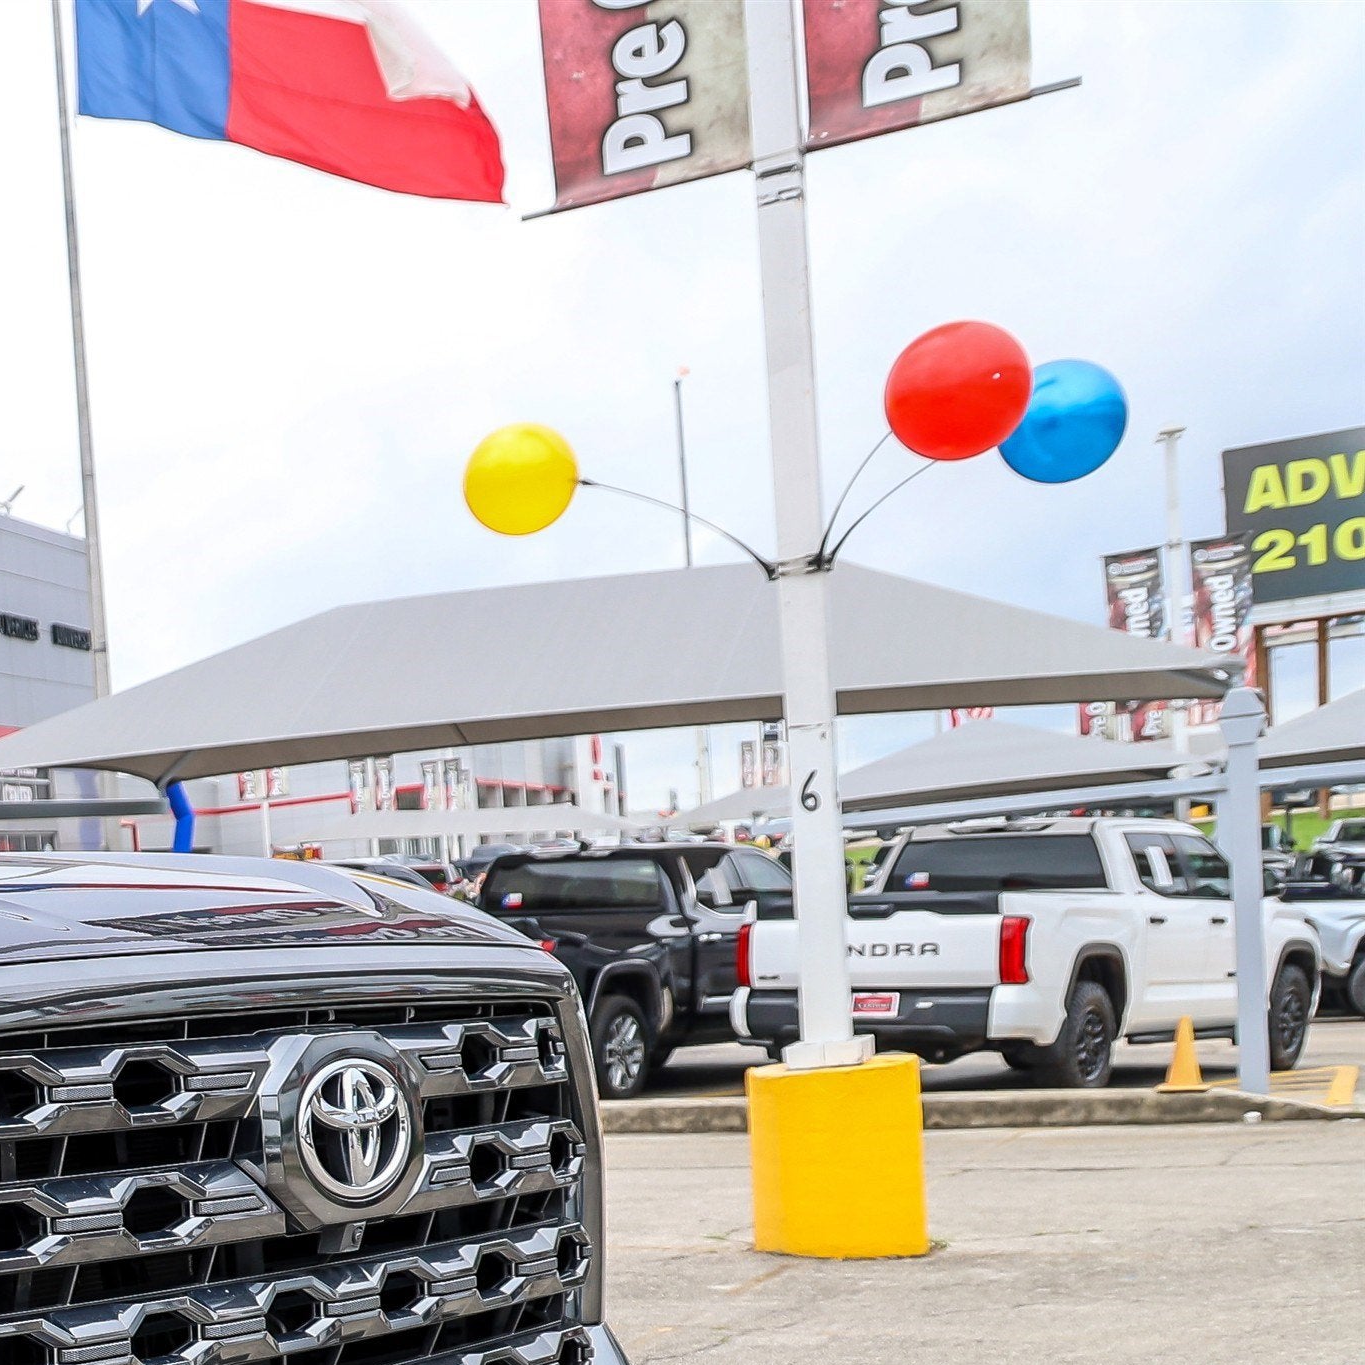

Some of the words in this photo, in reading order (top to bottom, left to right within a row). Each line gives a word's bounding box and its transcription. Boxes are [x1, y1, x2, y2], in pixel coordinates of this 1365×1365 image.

[861, 0, 964, 108] Pr
[600, 19, 692, 176] Pre
[1251, 516, 1365, 574] 210
[1202, 573, 1239, 652] Owned
[800, 769, 821, 812] 6
[846, 942, 941, 957] NDRA
